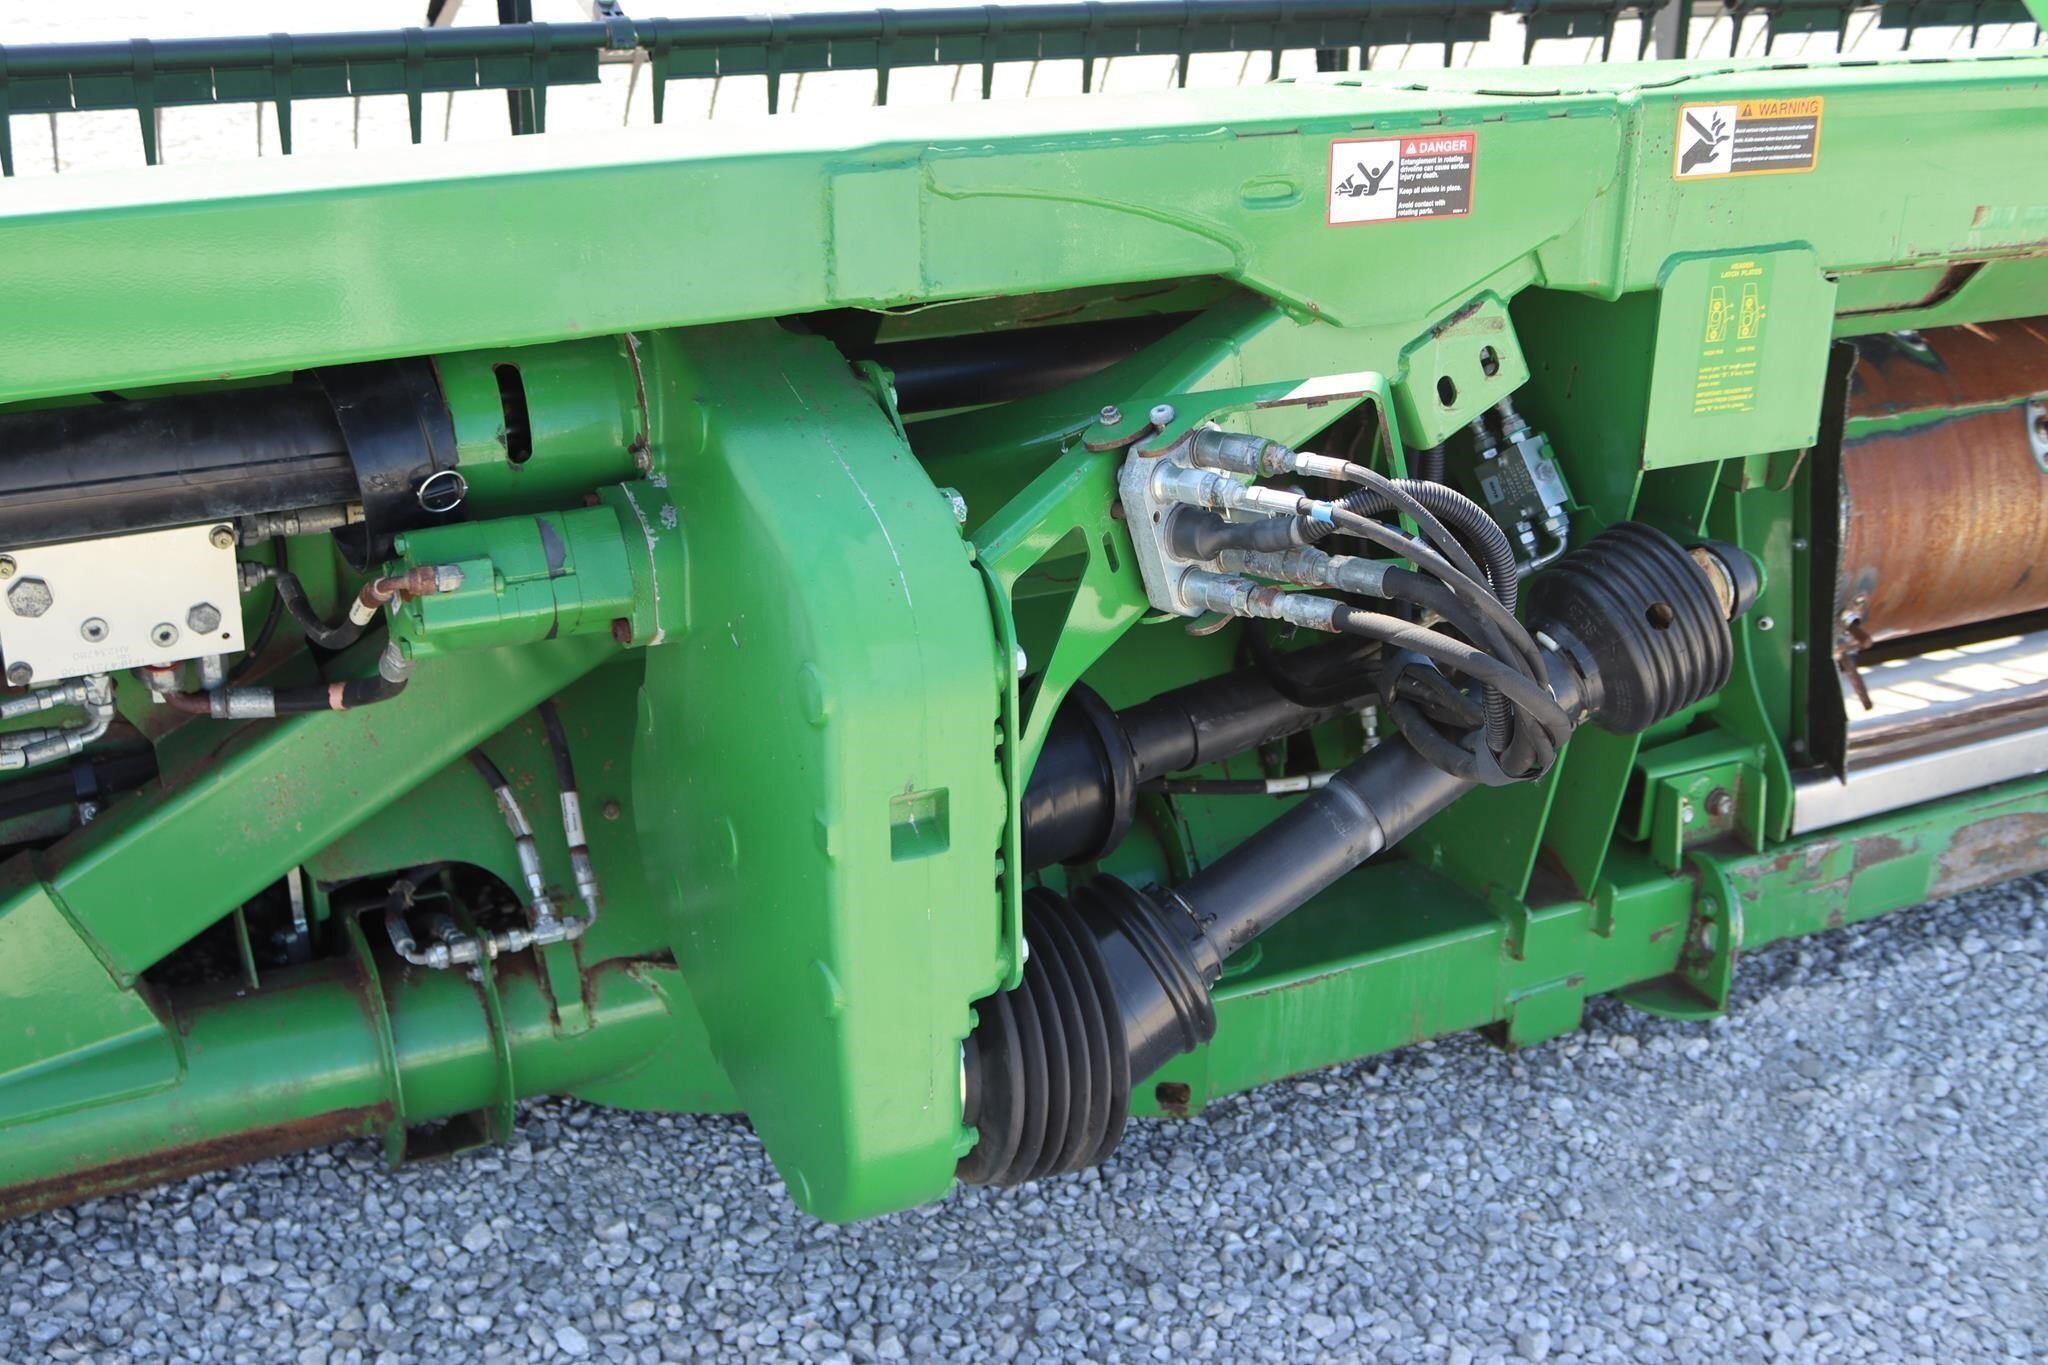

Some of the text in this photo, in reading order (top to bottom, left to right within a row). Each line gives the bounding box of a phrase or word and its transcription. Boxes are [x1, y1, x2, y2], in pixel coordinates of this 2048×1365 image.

[1760, 101, 1818, 116] WARNING
[1419, 140, 1467, 153] DANGER
[1401, 157, 1437, 165] Entanglement
[1400, 173, 1415, 181] injury
